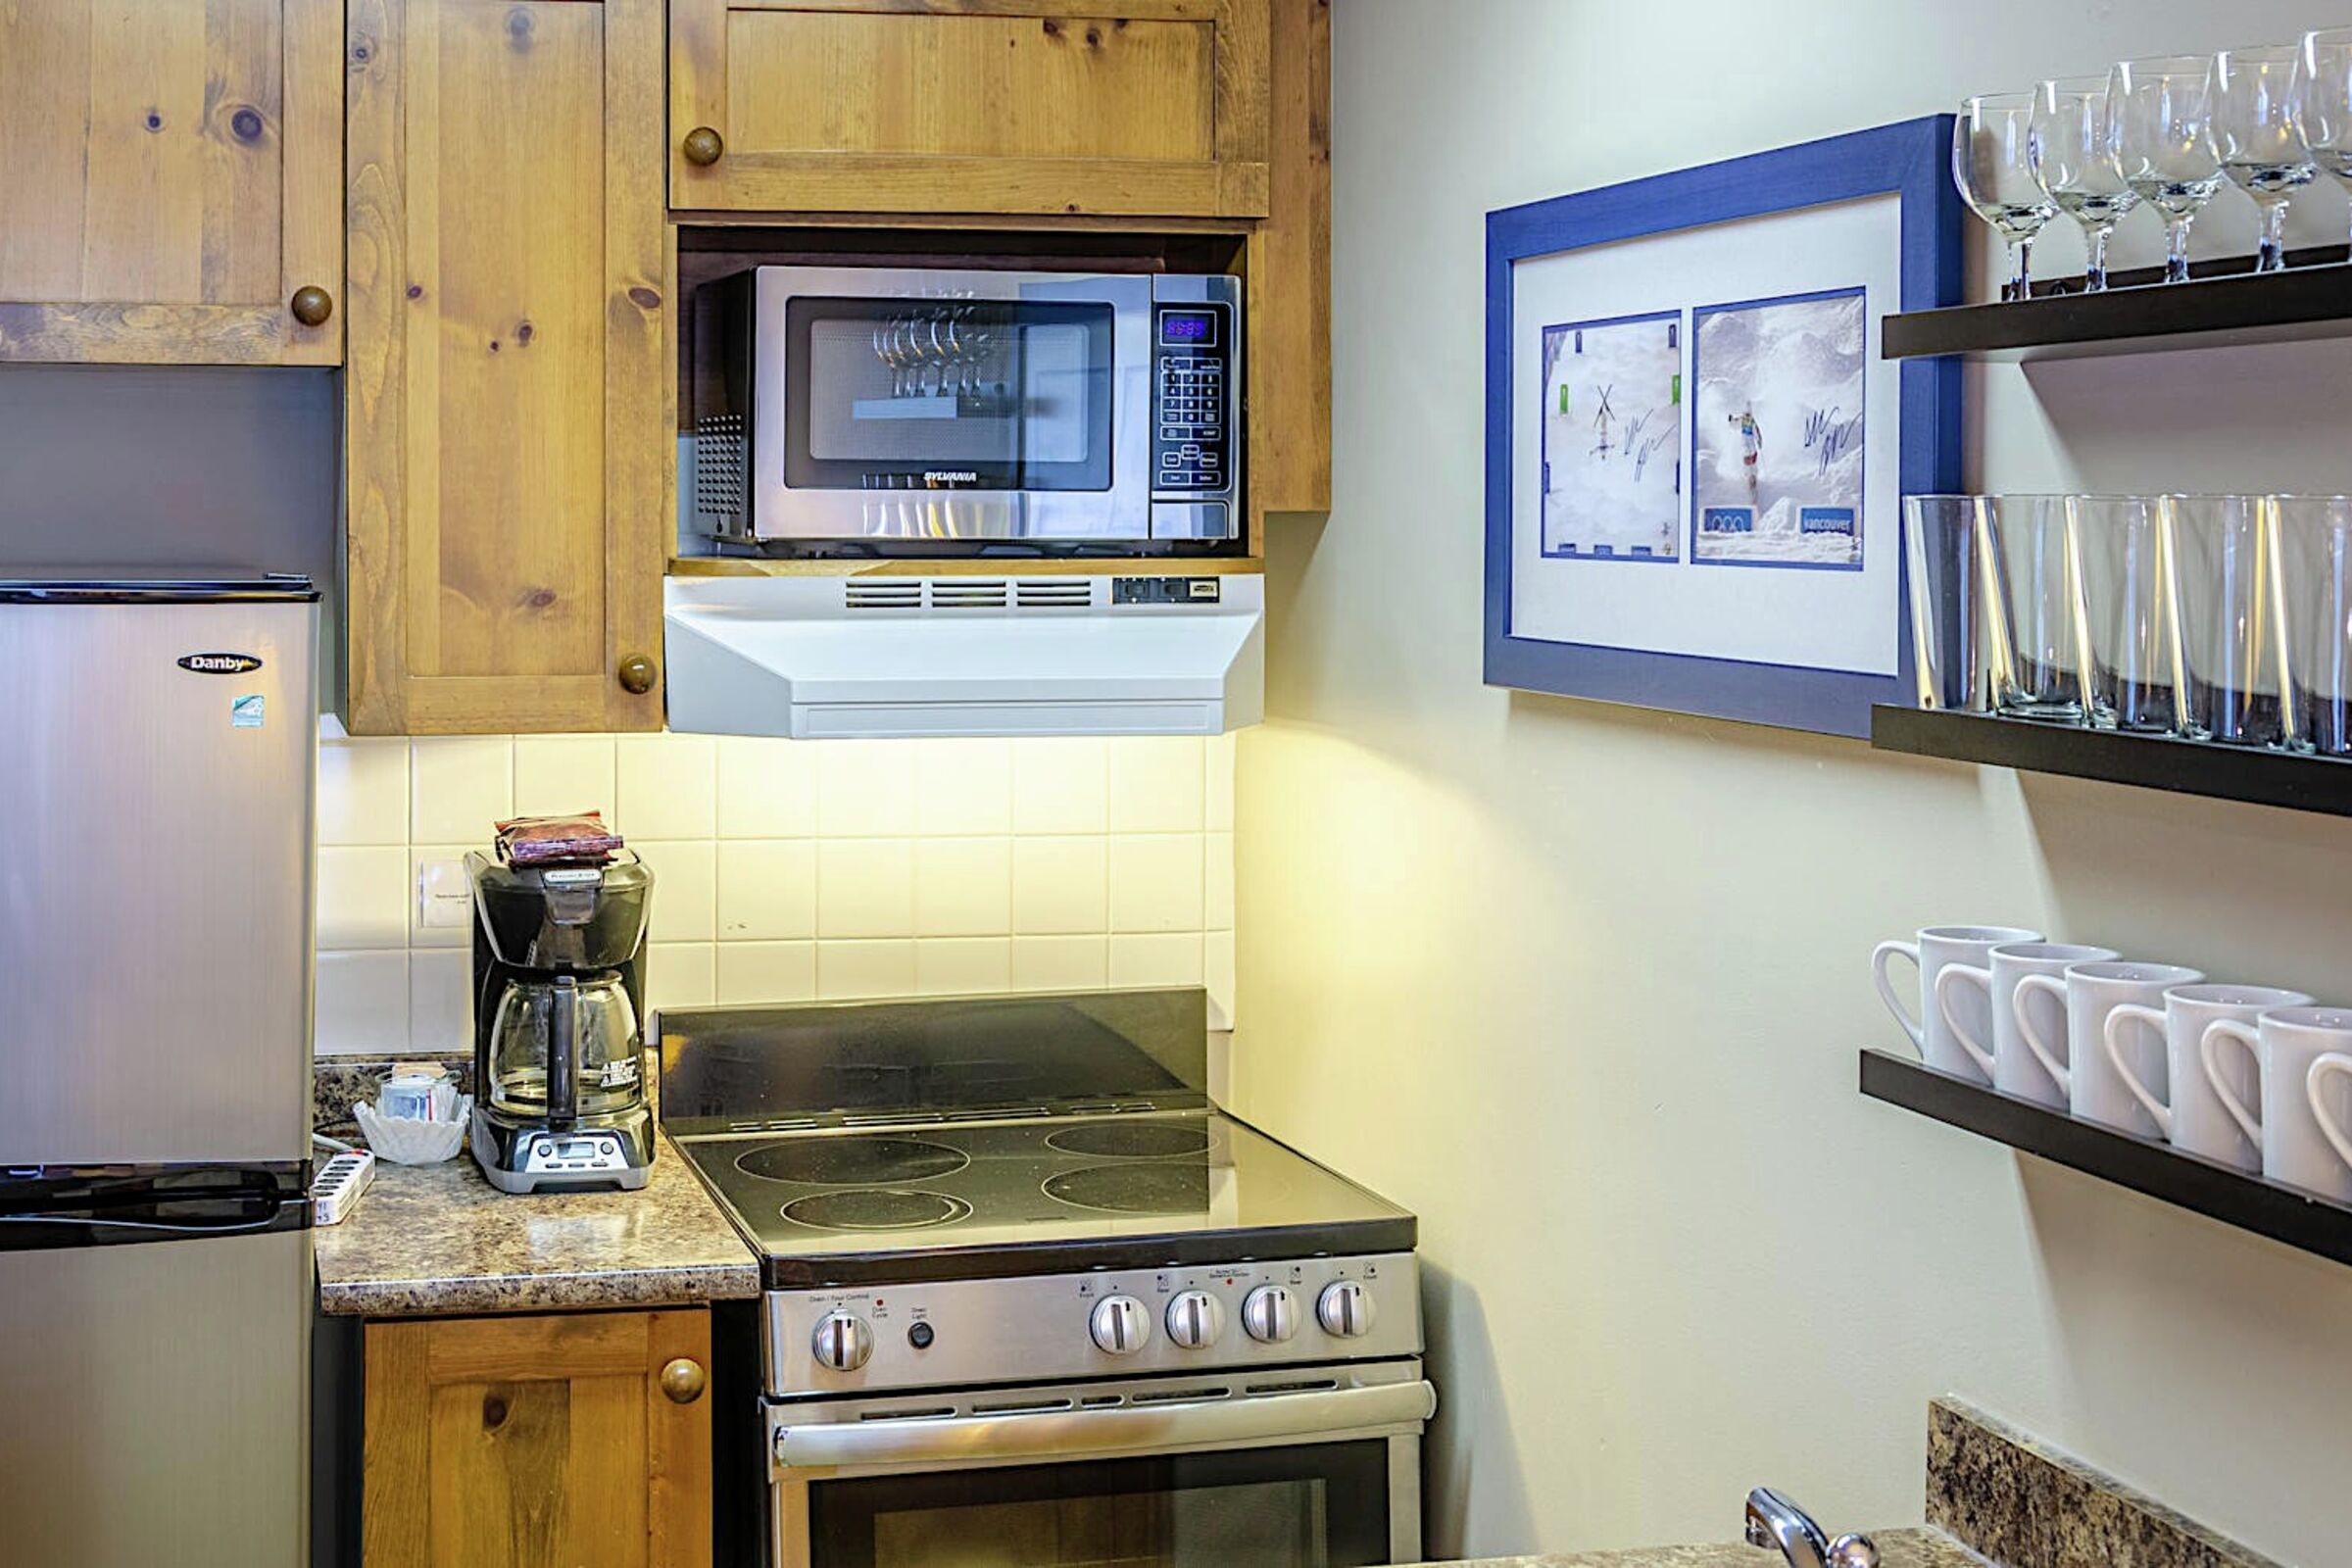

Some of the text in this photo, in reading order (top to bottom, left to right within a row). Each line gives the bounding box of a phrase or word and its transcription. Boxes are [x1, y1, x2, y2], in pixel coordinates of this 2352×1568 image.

[923, 471, 976, 482] SYLVANIA
[1804, 518, 1850, 531] vancouver
[191, 657, 244, 671] Danby
